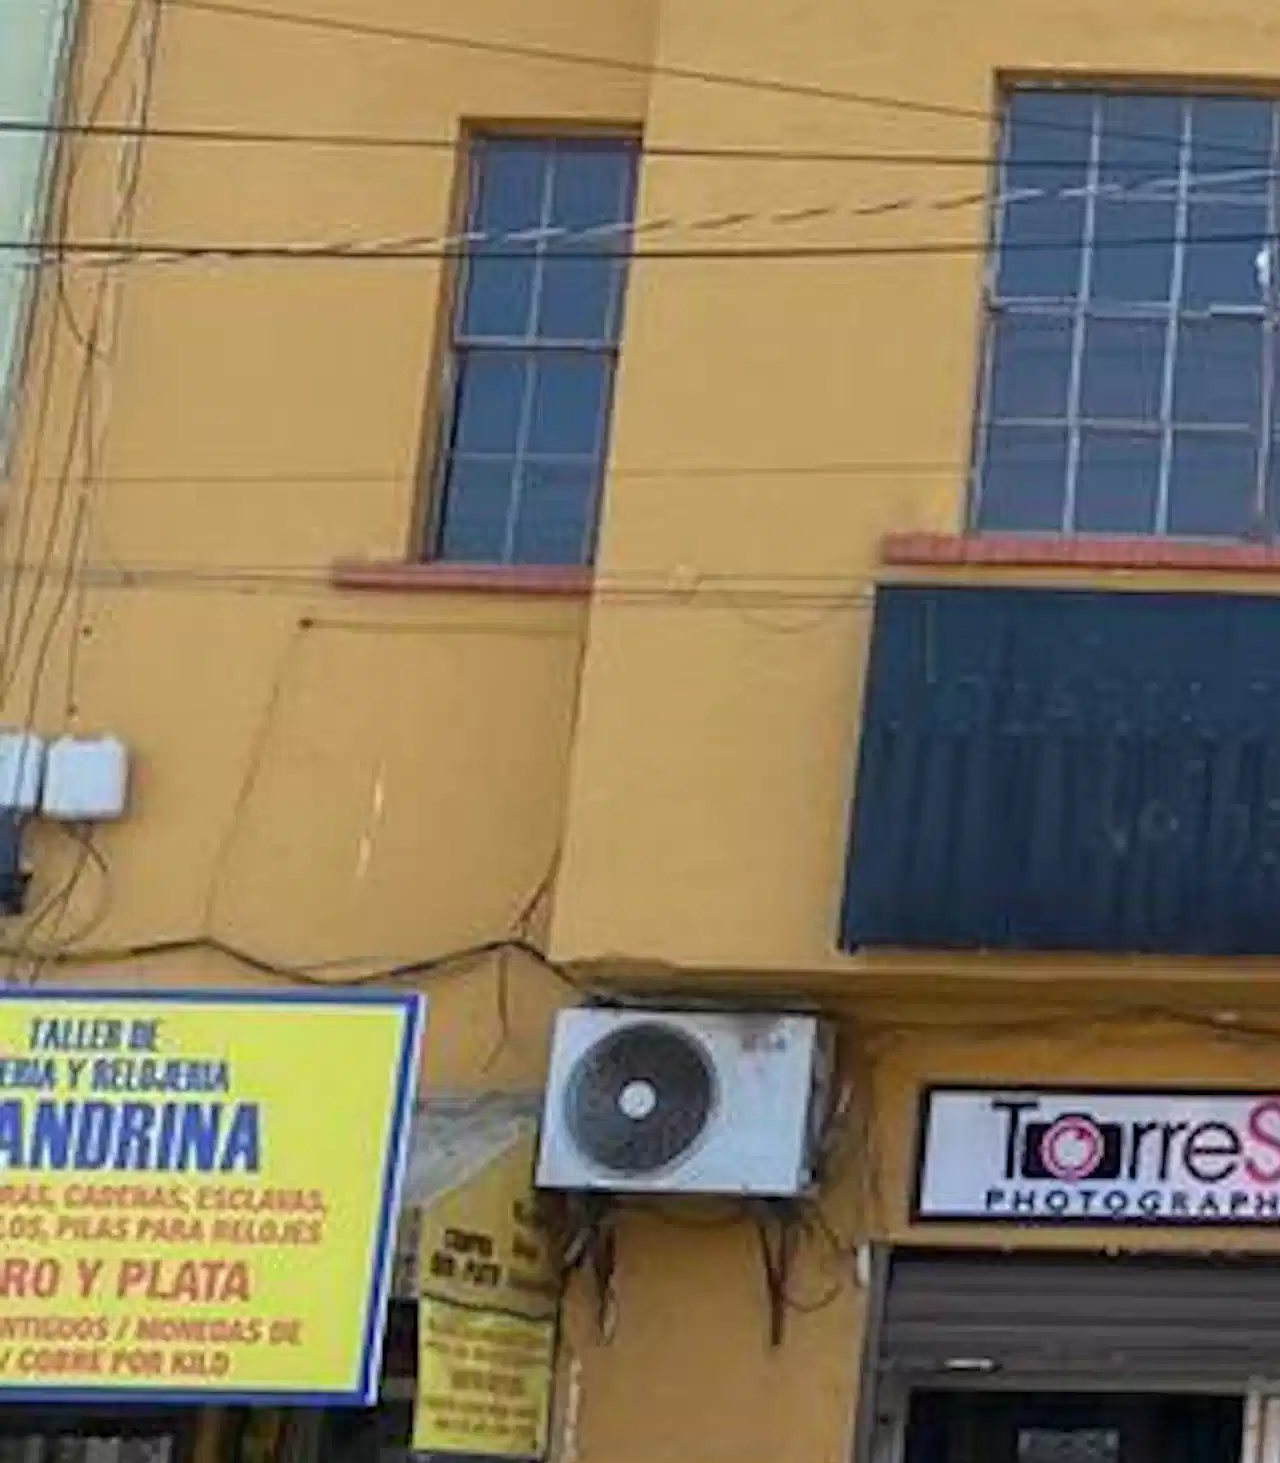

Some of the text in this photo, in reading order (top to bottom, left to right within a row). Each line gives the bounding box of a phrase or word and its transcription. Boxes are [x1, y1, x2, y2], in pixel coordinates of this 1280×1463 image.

[30, 1018, 158, 1052] TALLER DE
[68, 1058, 87, 1089] Y
[92, 1058, 230, 1093] RELOJERIA
[63, 1185, 195, 1213] CADENAS,
[197, 1187, 327, 1213] ESCLAVAS,
[56, 1215, 130, 1241] PILAS
[136, 1216, 205, 1242] PARA
[211, 1217, 324, 1245] RELOJES
[76, 1258, 102, 1300] Y
[117, 1259, 251, 1302] PLATA
[136, 1317, 263, 1344] MONEDAS
[109, 1349, 164, 1375] POR
[170, 1350, 231, 1377] KILO
